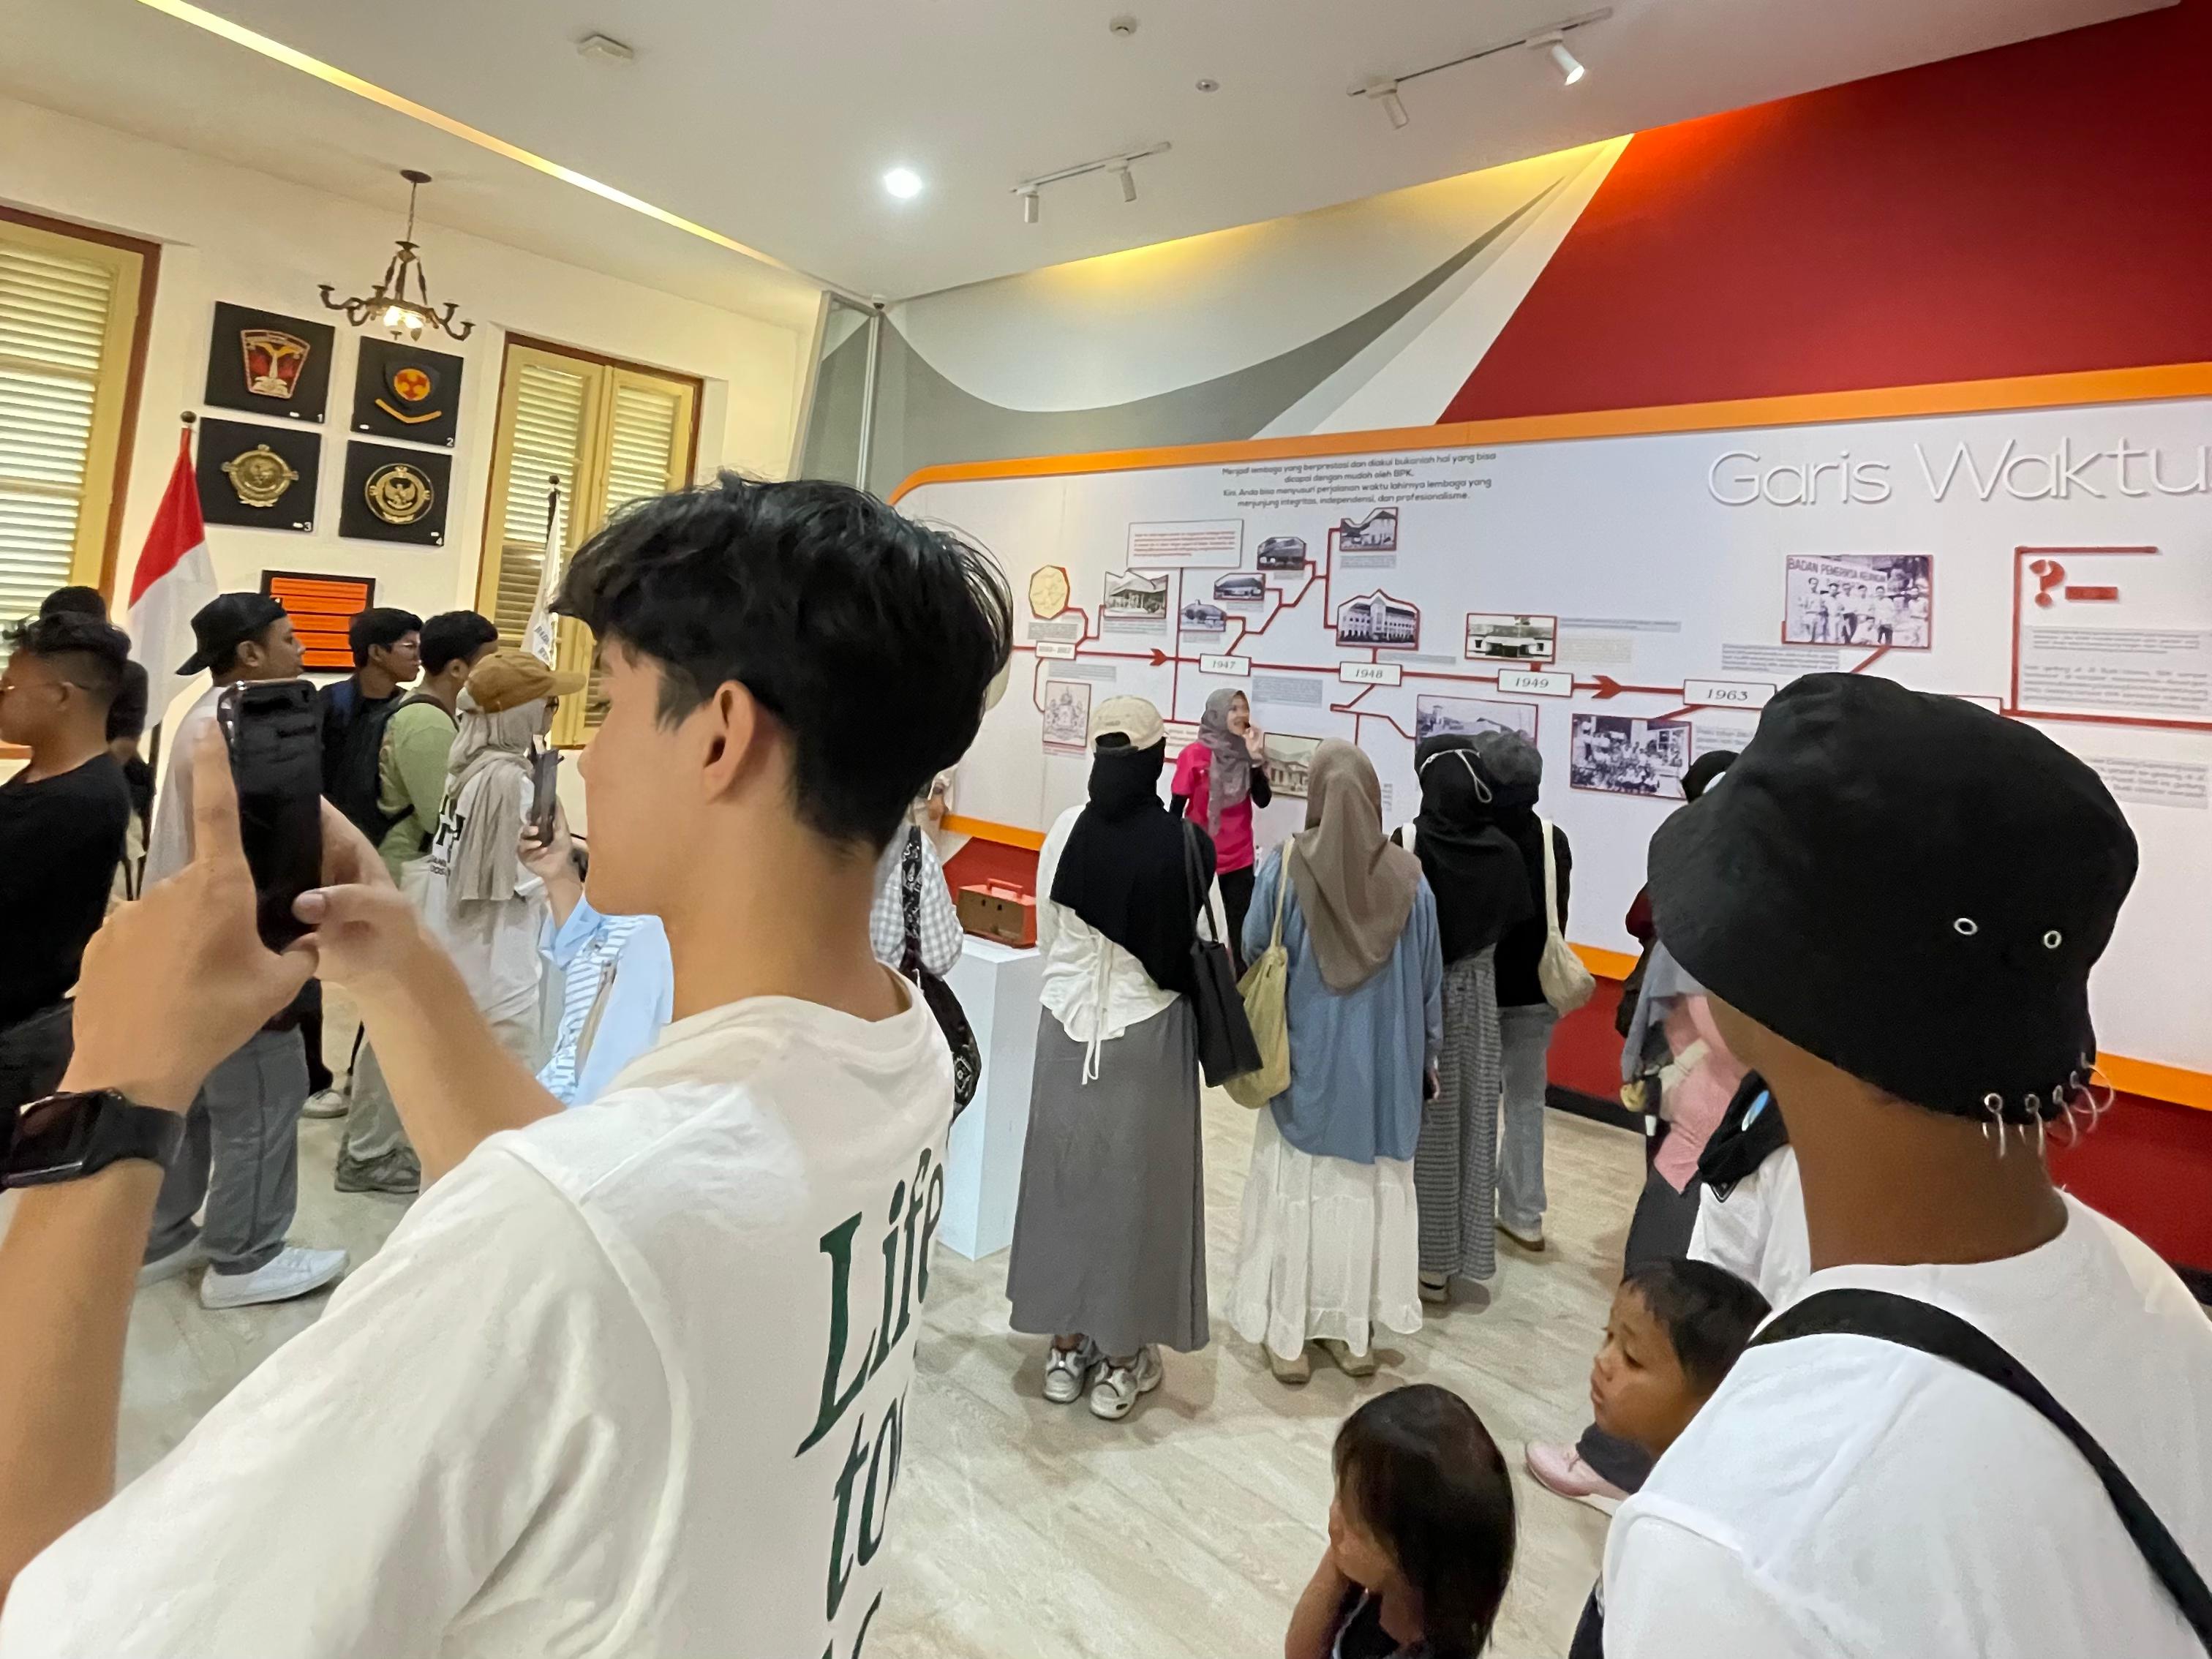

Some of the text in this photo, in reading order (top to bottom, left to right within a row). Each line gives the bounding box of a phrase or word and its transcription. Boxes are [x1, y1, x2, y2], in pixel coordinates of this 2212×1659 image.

[446, 437, 454, 447] 2
[1284, 464, 1302, 473] yang
[1304, 462, 1350, 472] berprestasi
[1368, 459, 1393, 467] diakui
[1437, 454, 1451, 464] hal
[1452, 453, 1475, 464] yang
[1476, 451, 1497, 461] bisa
[1707, 436, 2208, 506] Garis Waktu
[1313, 474, 1343, 484] dengan
[1344, 471, 1373, 480] mudah
[1238, 488, 1258, 496] Anda
[1317, 484, 1360, 494] perjalanan
[1361, 482, 1388, 491] waktu
[1390, 481, 1426, 490] lahirnya
[1426, 479, 1467, 490] lembaga
[1468, 478, 1492, 489] yang
[1320, 494, 1376, 505] independensi,
[1378, 493, 1394, 503] dan
[304, 522, 312, 532] 3
[1788, 558, 1818, 573] BADAN
[1211, 660, 1236, 670] 1947
[1355, 668, 1383, 679] 1948
[1514, 677, 1549, 688] 1949
[1707, 688, 1748, 701] 1963
